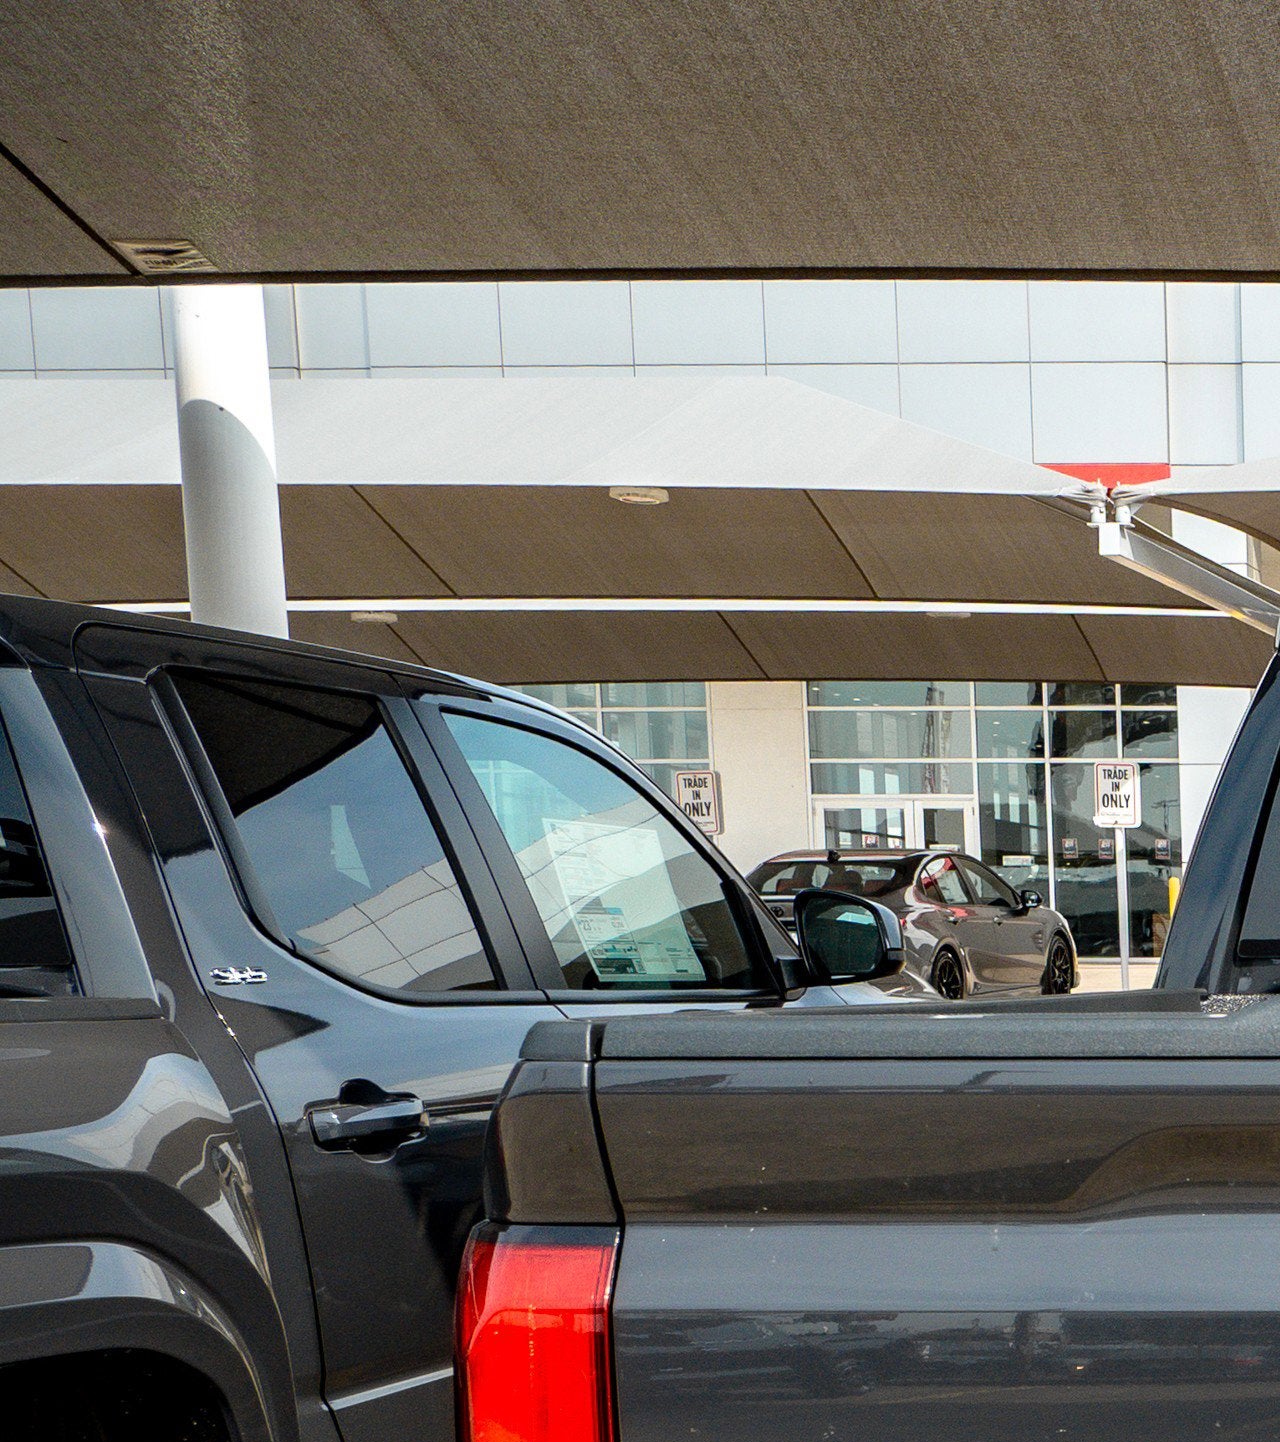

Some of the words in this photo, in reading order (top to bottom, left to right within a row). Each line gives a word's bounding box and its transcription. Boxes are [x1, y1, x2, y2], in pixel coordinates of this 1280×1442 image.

[1102, 769, 1129, 780] TRADE
[683, 778, 708, 788] TRADE
[1111, 782, 1120, 792] IN
[692, 790, 701, 800] IN
[1102, 793, 1131, 808] ONLY
[684, 802, 711, 817] ONLY
